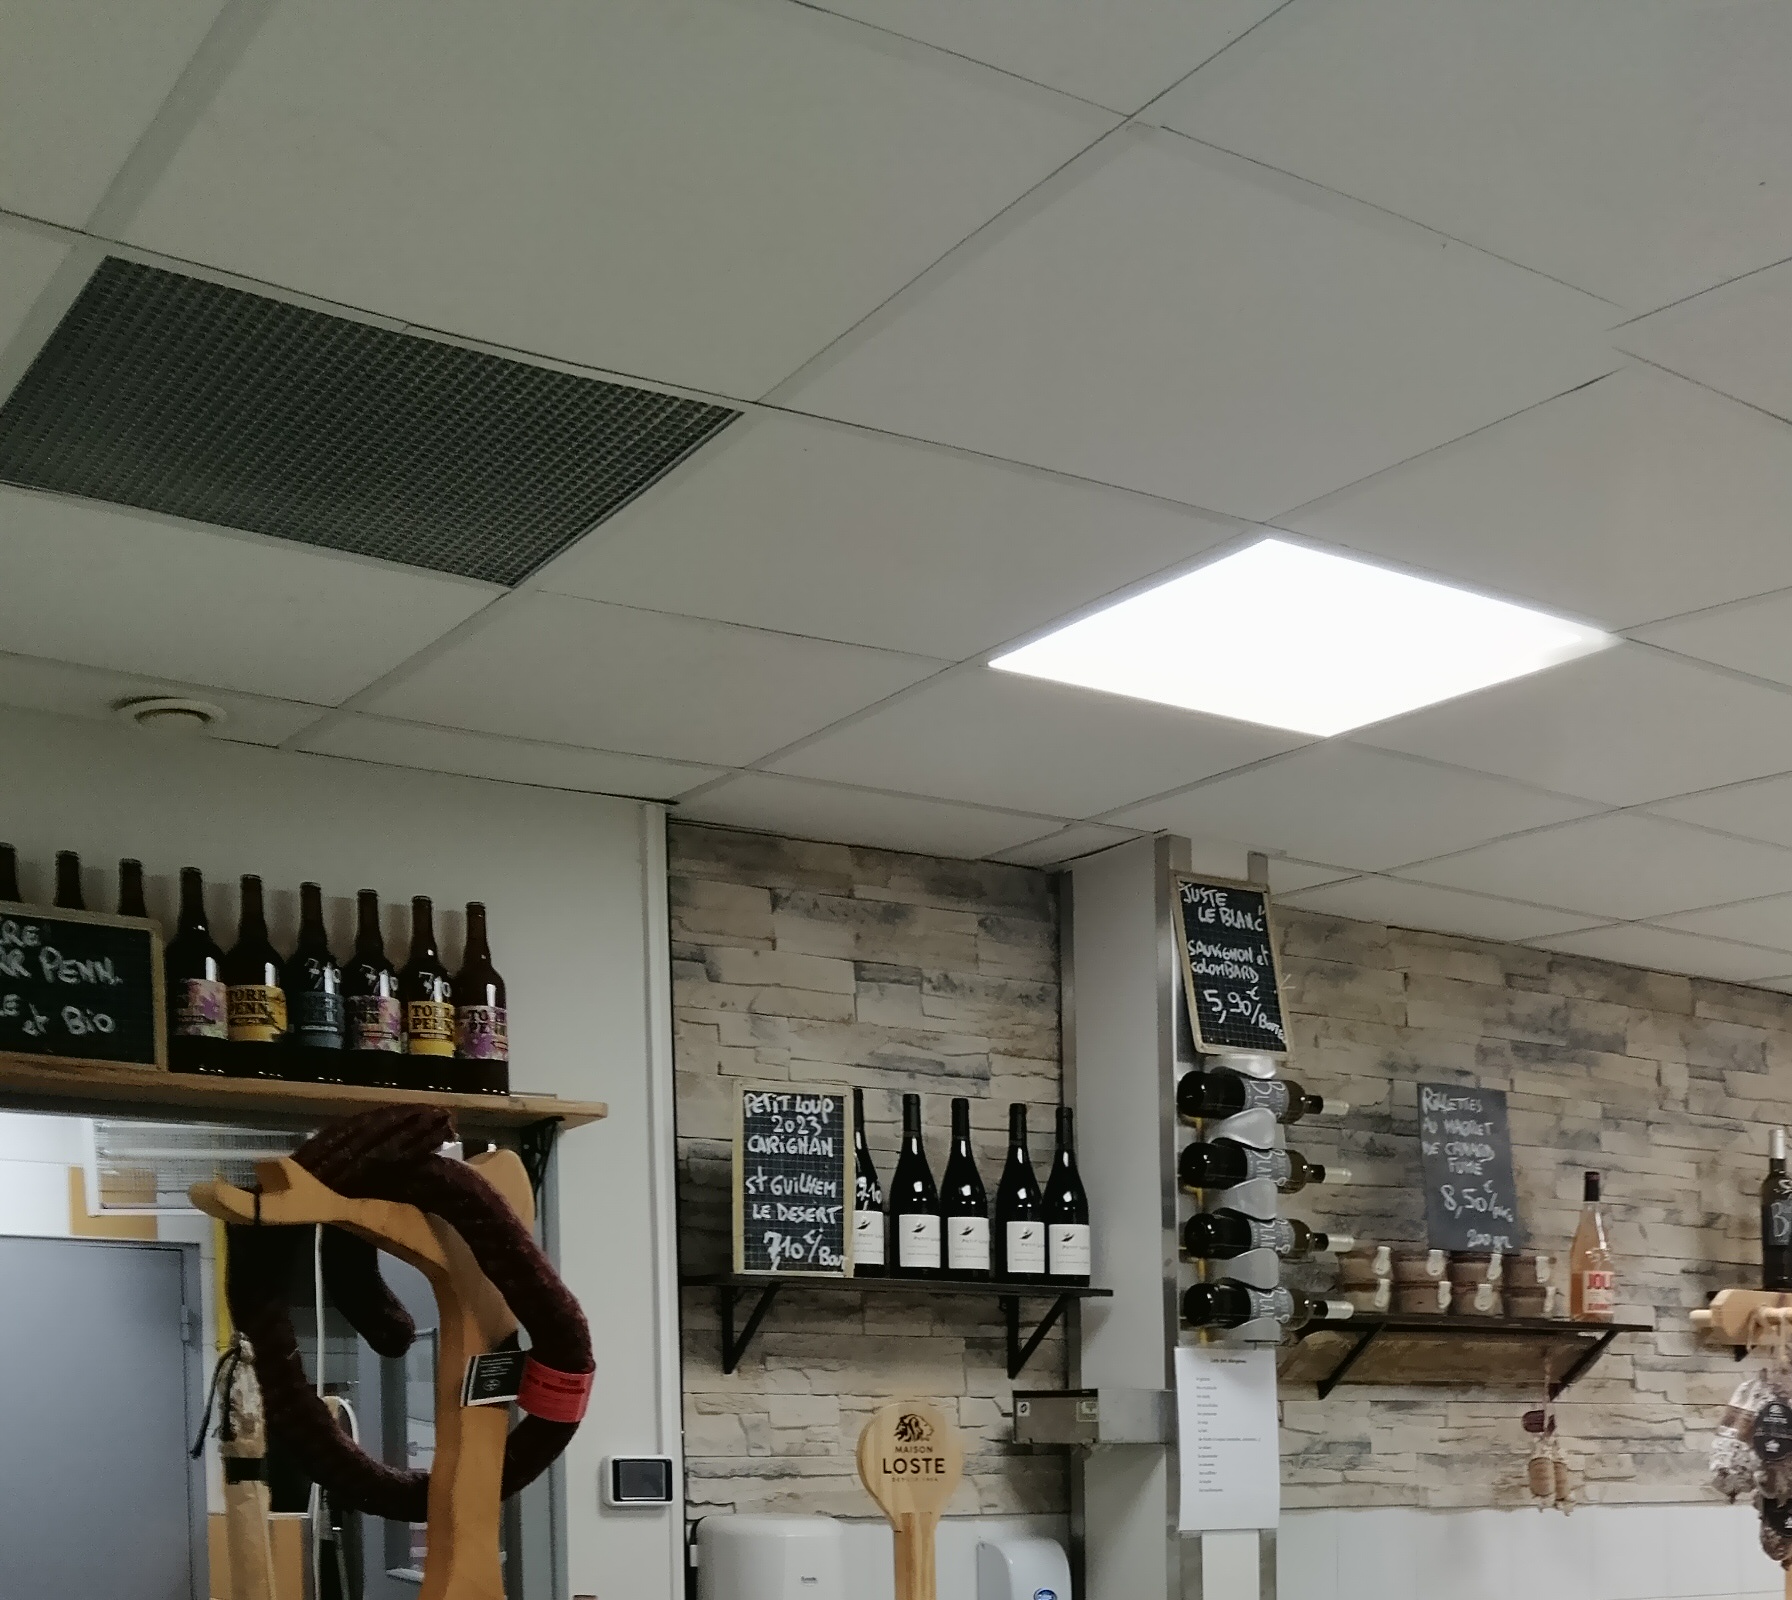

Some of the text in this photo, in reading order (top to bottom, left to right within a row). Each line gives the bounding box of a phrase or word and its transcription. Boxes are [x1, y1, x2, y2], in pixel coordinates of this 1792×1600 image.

[1198, 906, 1216, 924] LE
[61, 1005, 117, 1035] Bio
[794, 1093, 835, 1125] LOUP
[771, 1115, 822, 1136] 2023
[752, 1203, 772, 1219] LE
[894, 1445, 933, 1454] MAISON
[882, 1457, 946, 1475] LOSTE
